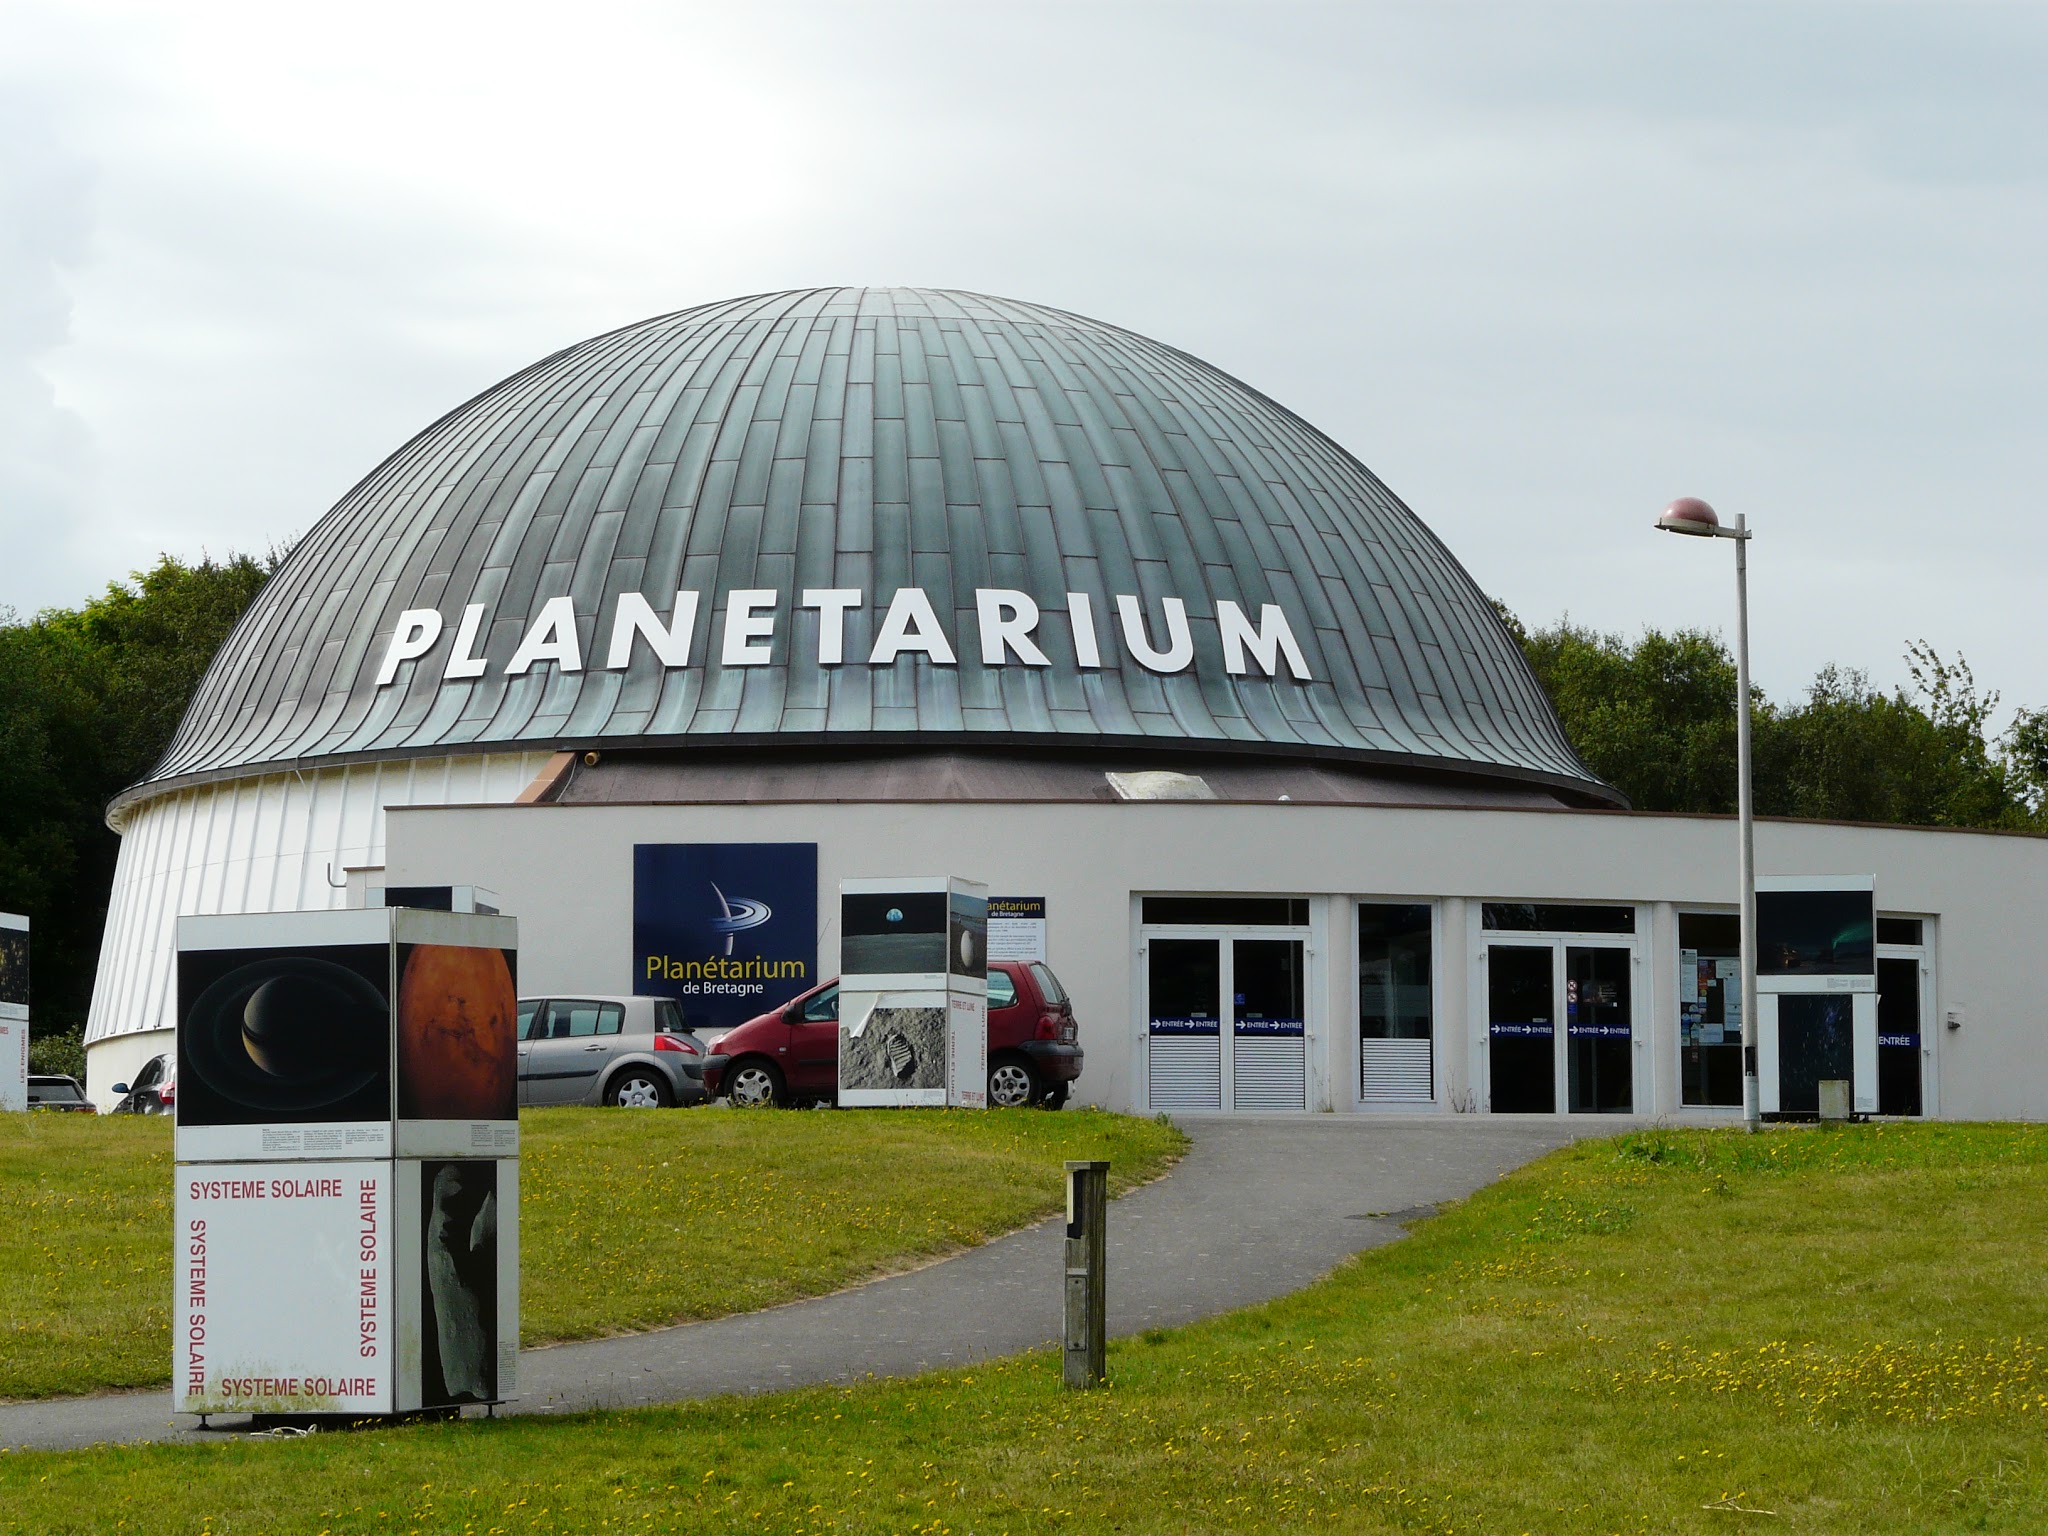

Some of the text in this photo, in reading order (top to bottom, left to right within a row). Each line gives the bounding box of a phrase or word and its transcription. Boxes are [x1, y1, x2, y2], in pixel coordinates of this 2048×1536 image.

[374, 587, 1313, 685] PLANETARIUM
[987, 900, 1041, 911] anétarium
[646, 954, 806, 980] Planétarium
[682, 981, 764, 997] de Bretagne
[1161, 1020, 1218, 1028] ENTRÉE ENTRÉE
[1246, 1020, 1303, 1029] ENTRÉE ENTRÉE
[1501, 1025, 1553, 1034] ENTRÉE ENTRÉE
[1579, 1026, 1630, 1035] ENTRÉE ENTRÉE
[1878, 1034, 1910, 1046] ENTRÉE
[190, 1179, 343, 1200] SYSTEME SOLAIRE
[360, 1179, 377, 1358] SYSTEME SOLAIRE
[188, 1219, 206, 1396] SYSTEME SOLAIRE
[221, 1377, 376, 1397] SYSTEME SOLAIRE
